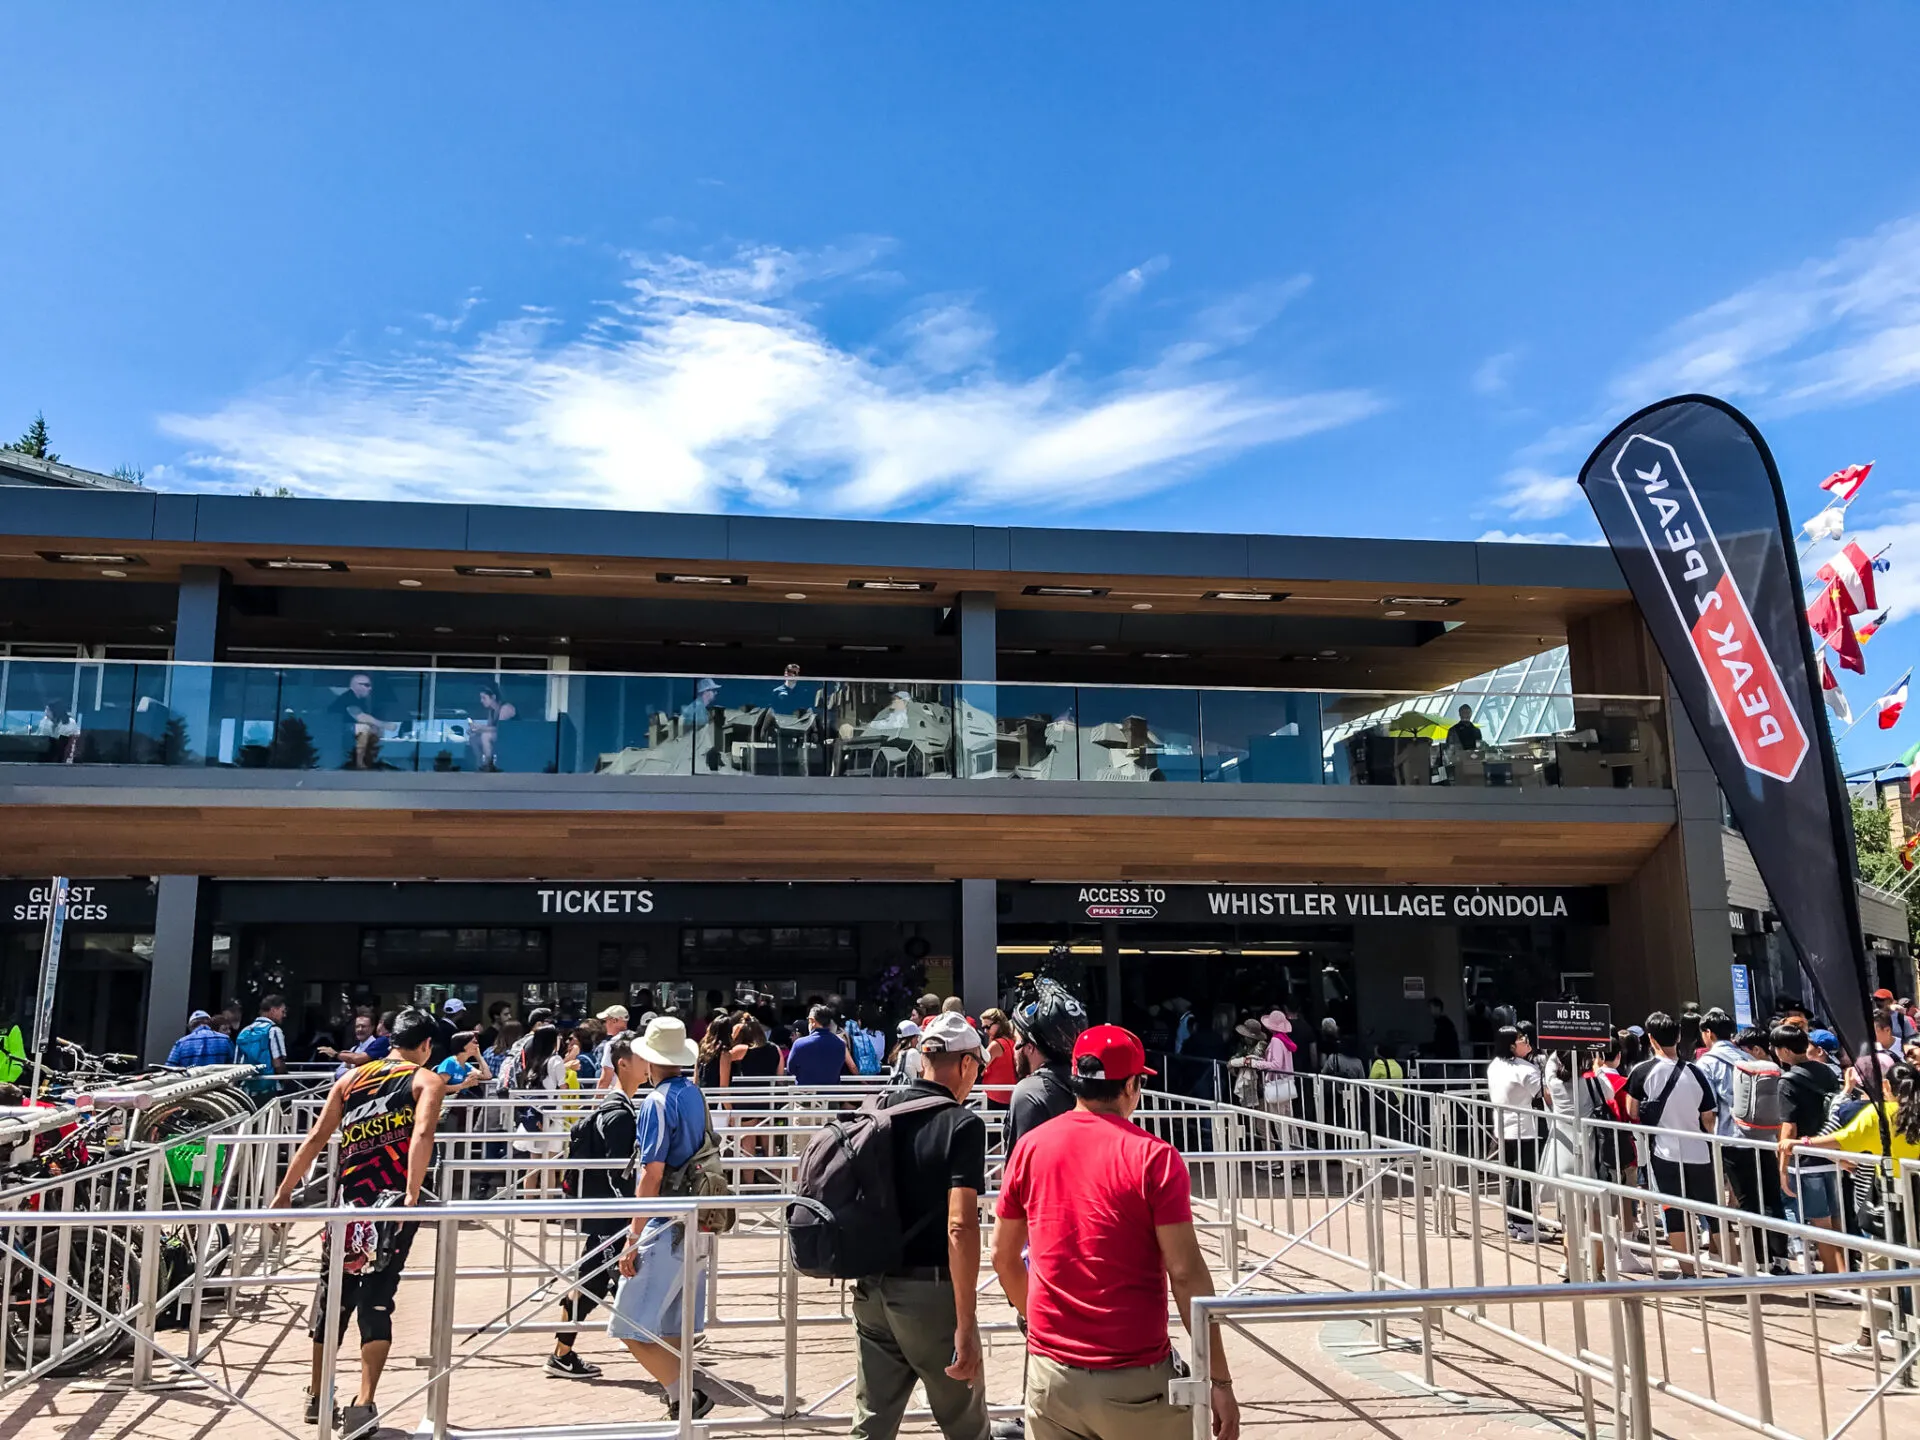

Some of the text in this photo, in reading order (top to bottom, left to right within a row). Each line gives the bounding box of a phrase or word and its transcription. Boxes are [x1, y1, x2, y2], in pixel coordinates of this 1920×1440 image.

[29, 887, 96, 903] GUST
[537, 890, 654, 913] TICKETS
[1078, 888, 1166, 903] ACCESS TO
[13, 904, 108, 921] SERICES
[1126, 908, 1151, 916] PEAK
[1207, 892, 1568, 917] WHISTLER VILLAGE GONDOLA
[1557, 1009, 1591, 1020] NO PETS
